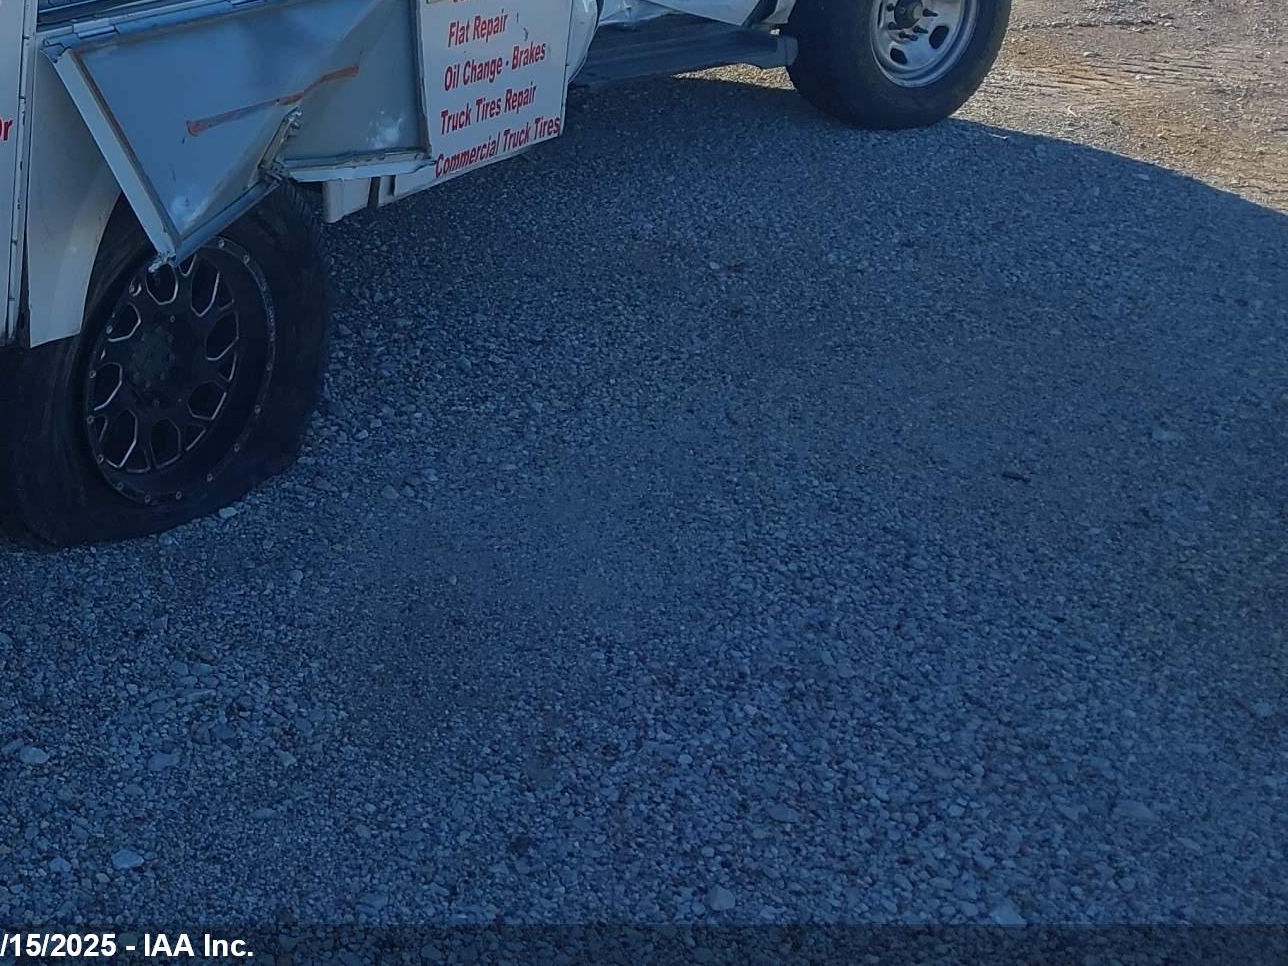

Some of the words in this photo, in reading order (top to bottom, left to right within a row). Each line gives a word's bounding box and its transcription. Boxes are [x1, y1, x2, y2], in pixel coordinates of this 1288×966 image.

[447, 17, 471, 48] Flat
[472, 8, 509, 44] Repair
[444, 63, 461, 92] Oil
[462, 56, 503, 84] Change
[511, 42, 547, 70] Brakes
[440, 103, 472, 136] Truck
[475, 96, 502, 123] Tires
[504, 81, 537, 115] Repair
[435, 131, 501, 179] Commercial
[503, 122, 532, 153] Truck
[533, 116, 562, 141] Tires
